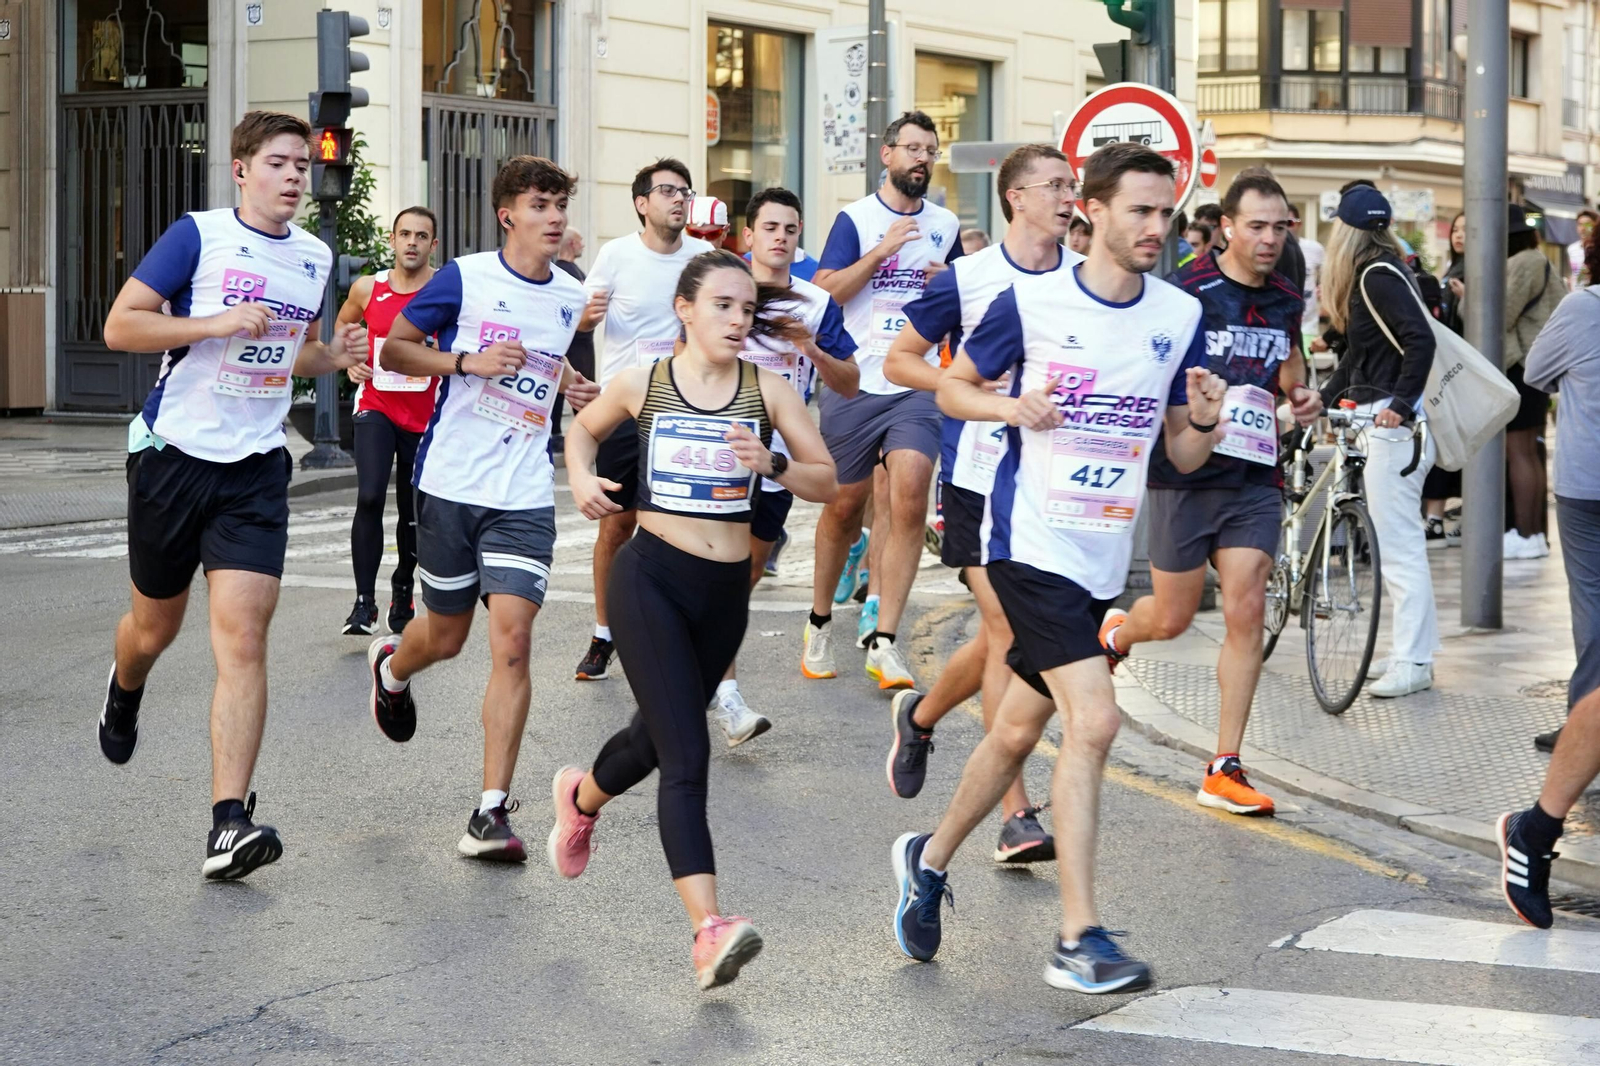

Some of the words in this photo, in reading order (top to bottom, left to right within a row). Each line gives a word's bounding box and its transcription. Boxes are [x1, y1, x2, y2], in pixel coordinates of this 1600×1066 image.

[237, 345, 286, 364] 203
[498, 371, 550, 401] 206
[1230, 406, 1273, 432] 1067
[671, 445, 736, 472] 418
[1070, 464, 1127, 489] 417
